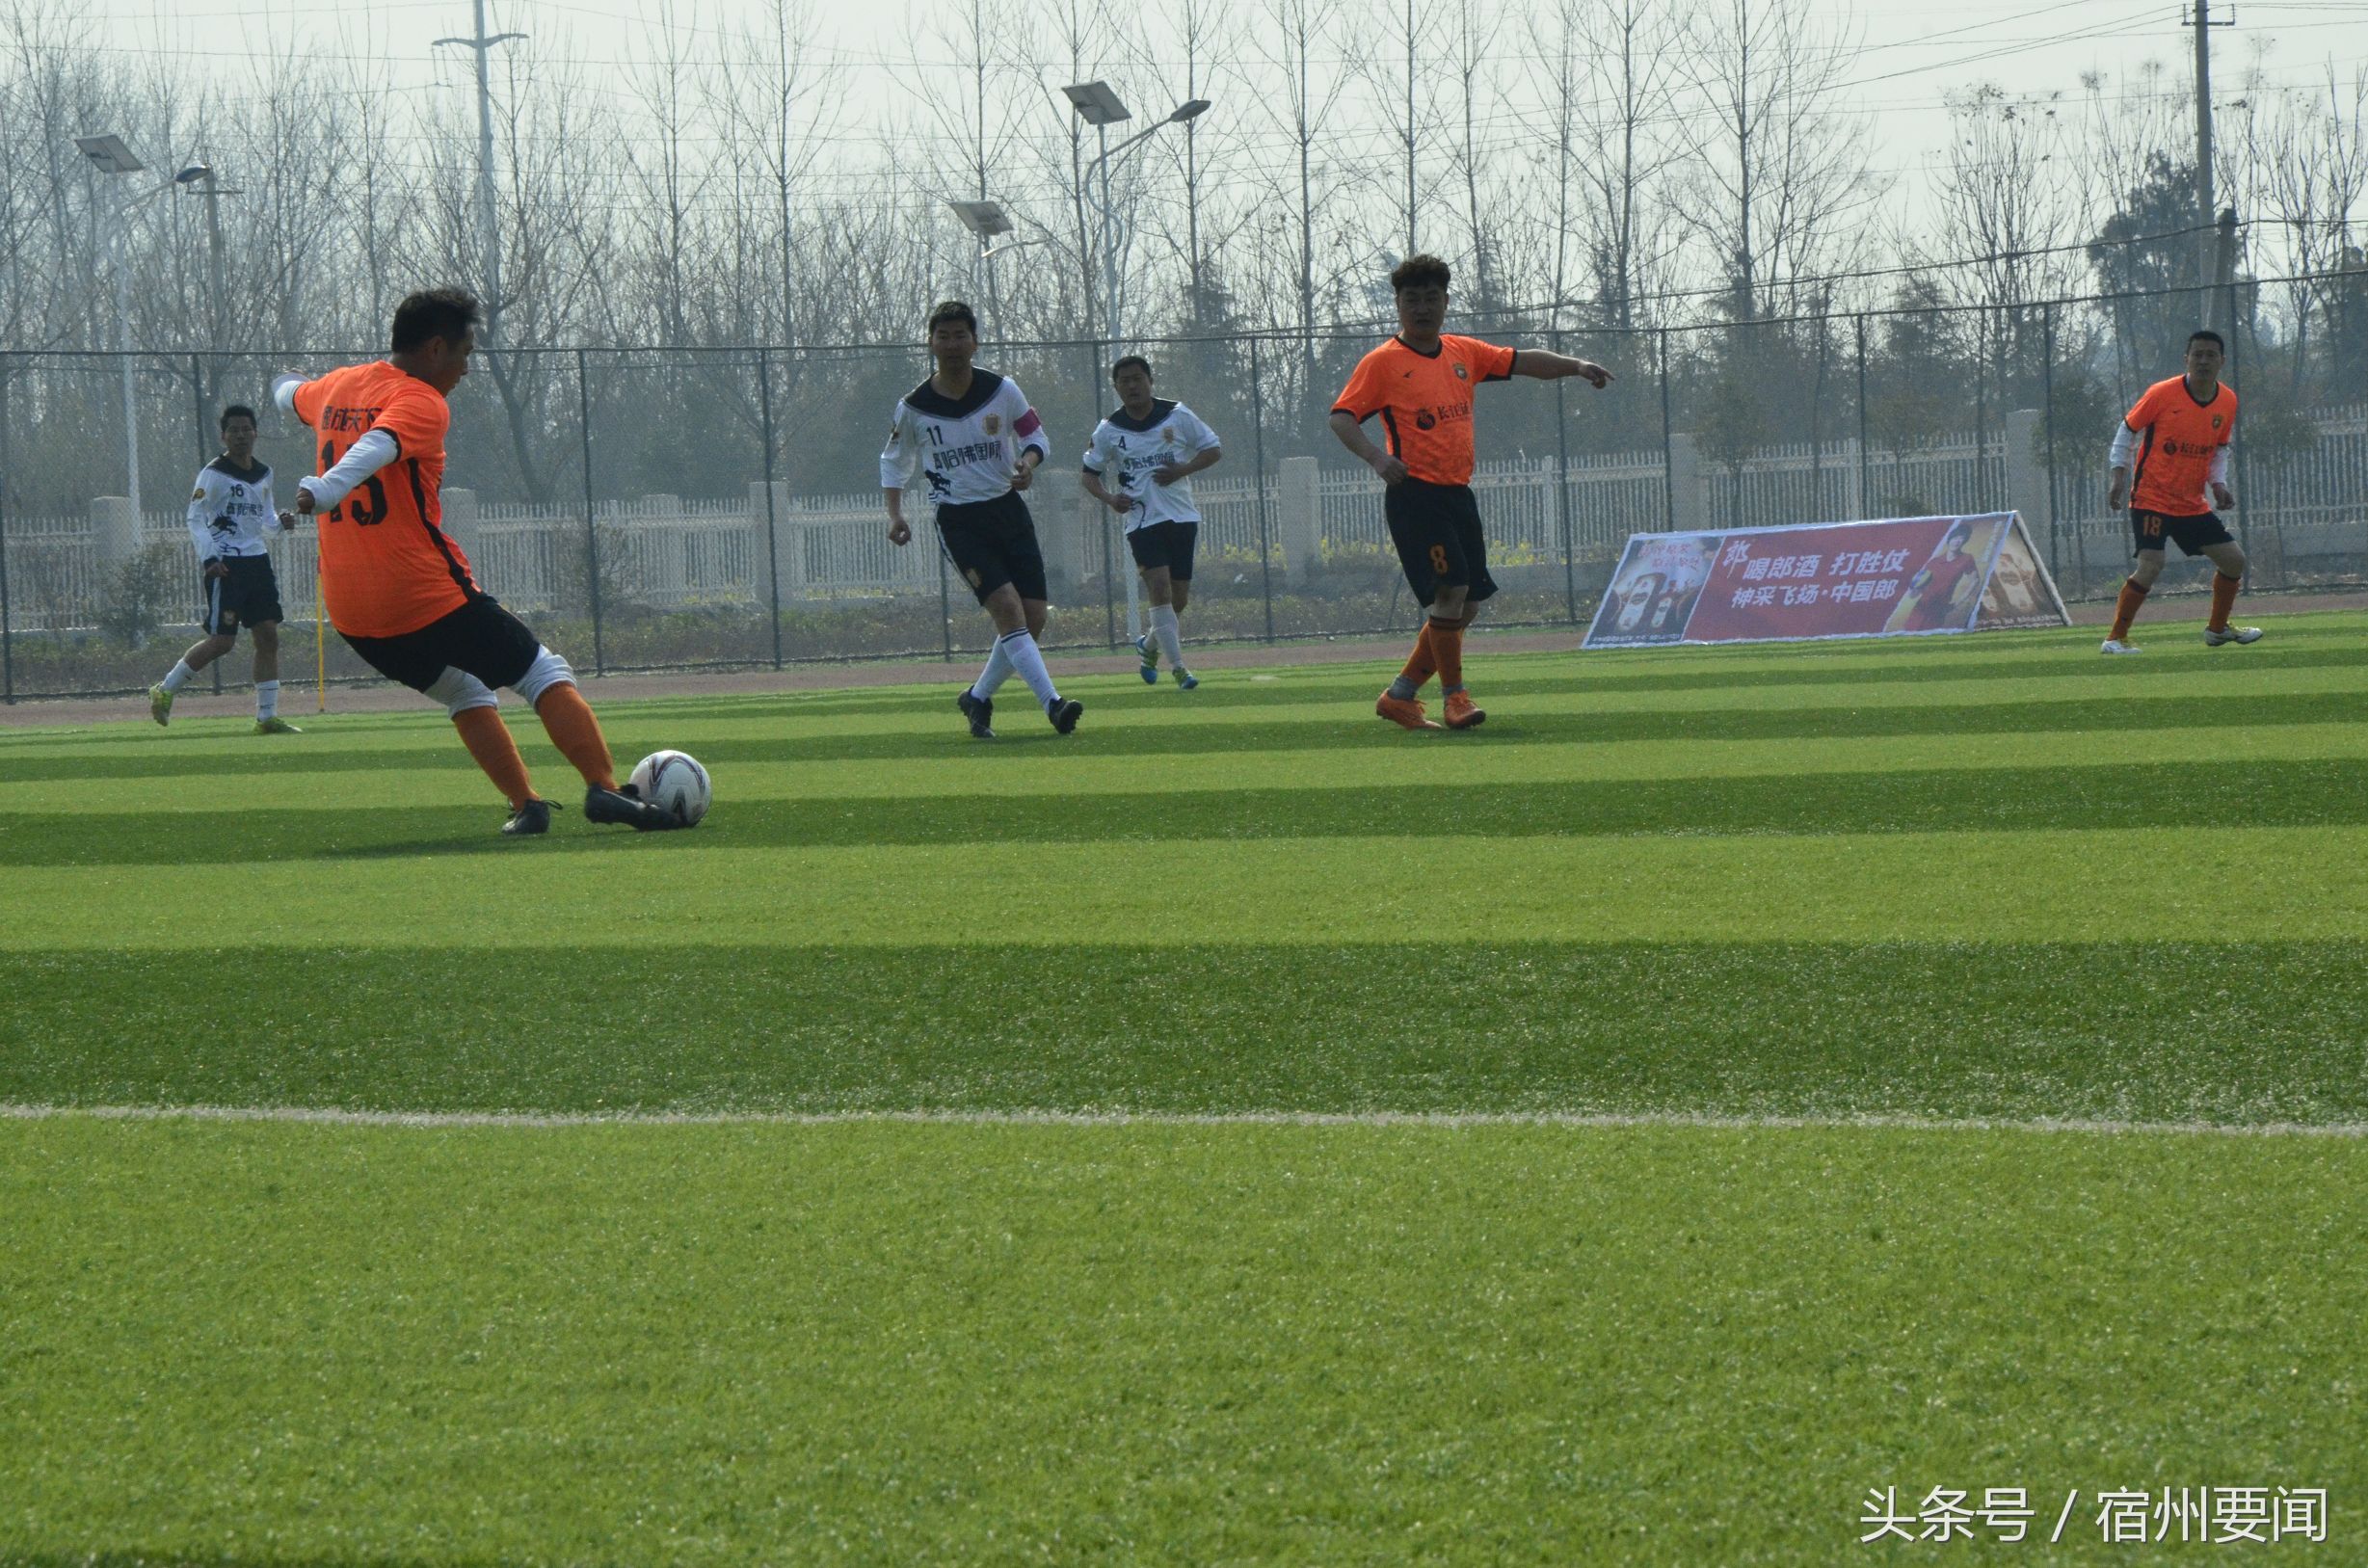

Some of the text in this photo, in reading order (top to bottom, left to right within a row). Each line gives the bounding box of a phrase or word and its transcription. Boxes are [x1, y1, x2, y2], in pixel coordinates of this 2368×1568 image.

[926, 425, 943, 446] 11
[1118, 436, 1127, 450] 4
[230, 484, 244, 497] 16
[2142, 515, 2163, 538] 18
[1429, 544, 1449, 575] 8
[1743, 548, 1910, 581] 喝郎酒 打胜仗
